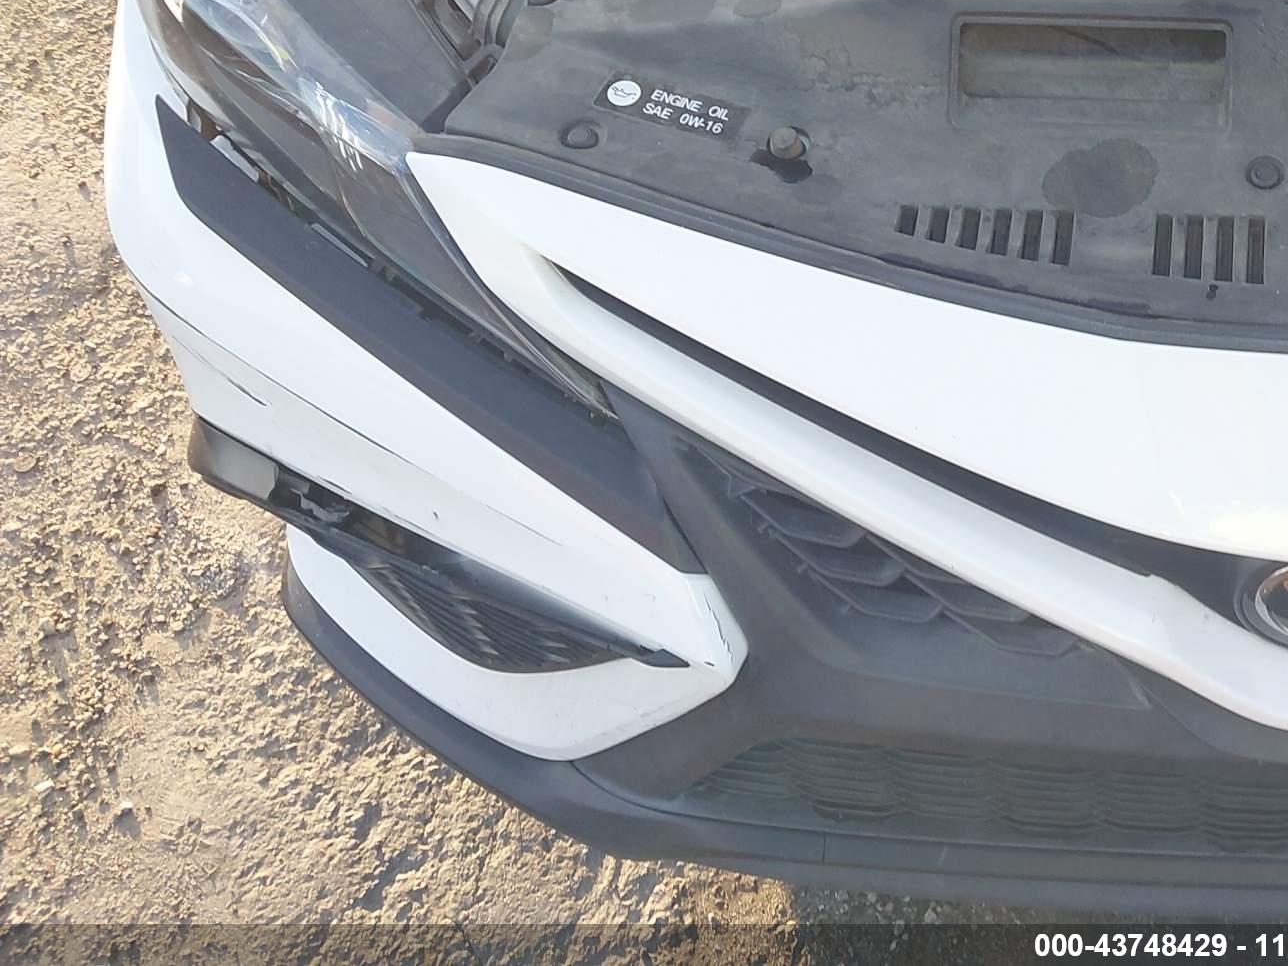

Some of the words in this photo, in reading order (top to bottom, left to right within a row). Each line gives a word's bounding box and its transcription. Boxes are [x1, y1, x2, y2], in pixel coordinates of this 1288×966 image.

[642, 102, 674, 120] SAE
[679, 113, 724, 134] 0W-16
[650, 89, 703, 113] ENGINE
[708, 105, 729, 121] OIL
